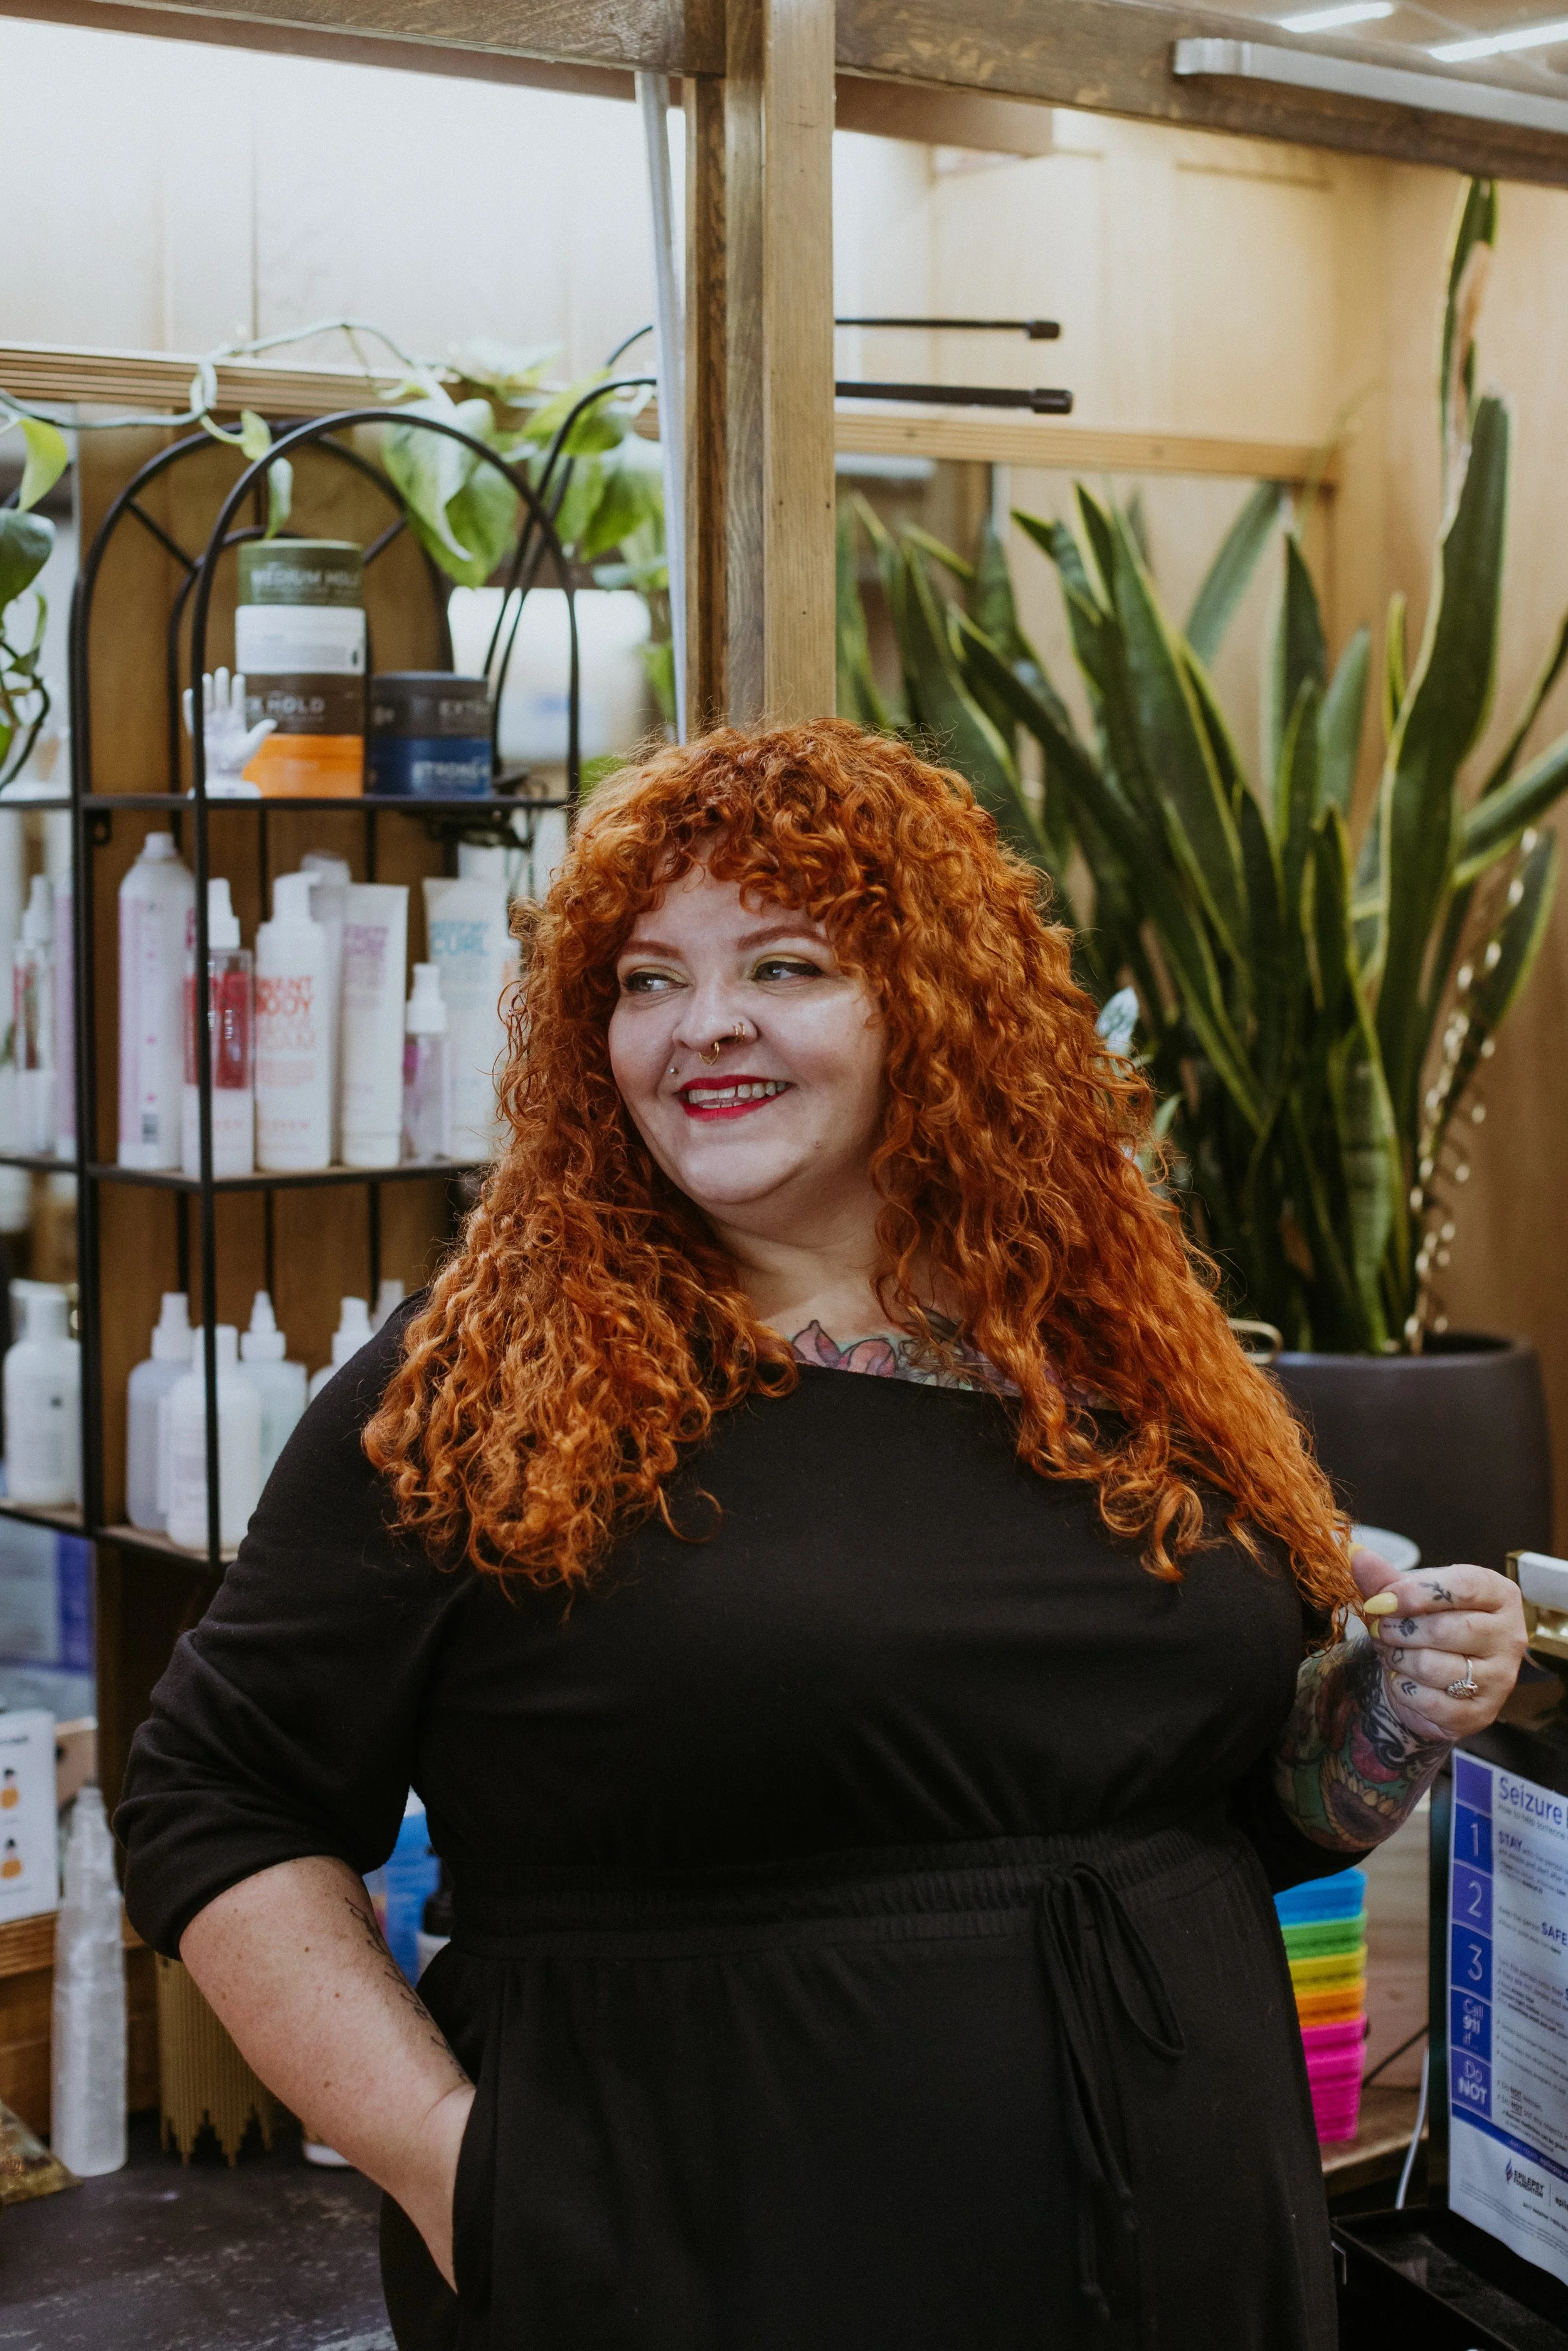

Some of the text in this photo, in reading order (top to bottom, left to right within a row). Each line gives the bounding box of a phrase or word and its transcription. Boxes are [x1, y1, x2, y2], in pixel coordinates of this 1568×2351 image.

[1499, 1776, 1562, 1825] Seizure
[1471, 1823, 1479, 1857] 1
[1498, 1830, 1522, 1850] STAY
[1468, 1882, 1482, 1918] 2
[1542, 1921, 1567, 1946] SAFE
[1468, 1943, 1482, 1981] 3
[1463, 1998, 1484, 2020] Call
[1463, 2014, 1480, 2035] 911
[1465, 2059, 1483, 2083] Do
[1458, 2076, 1487, 2105] NOT
[1514, 2170, 1544, 2192] EPILEPSY
